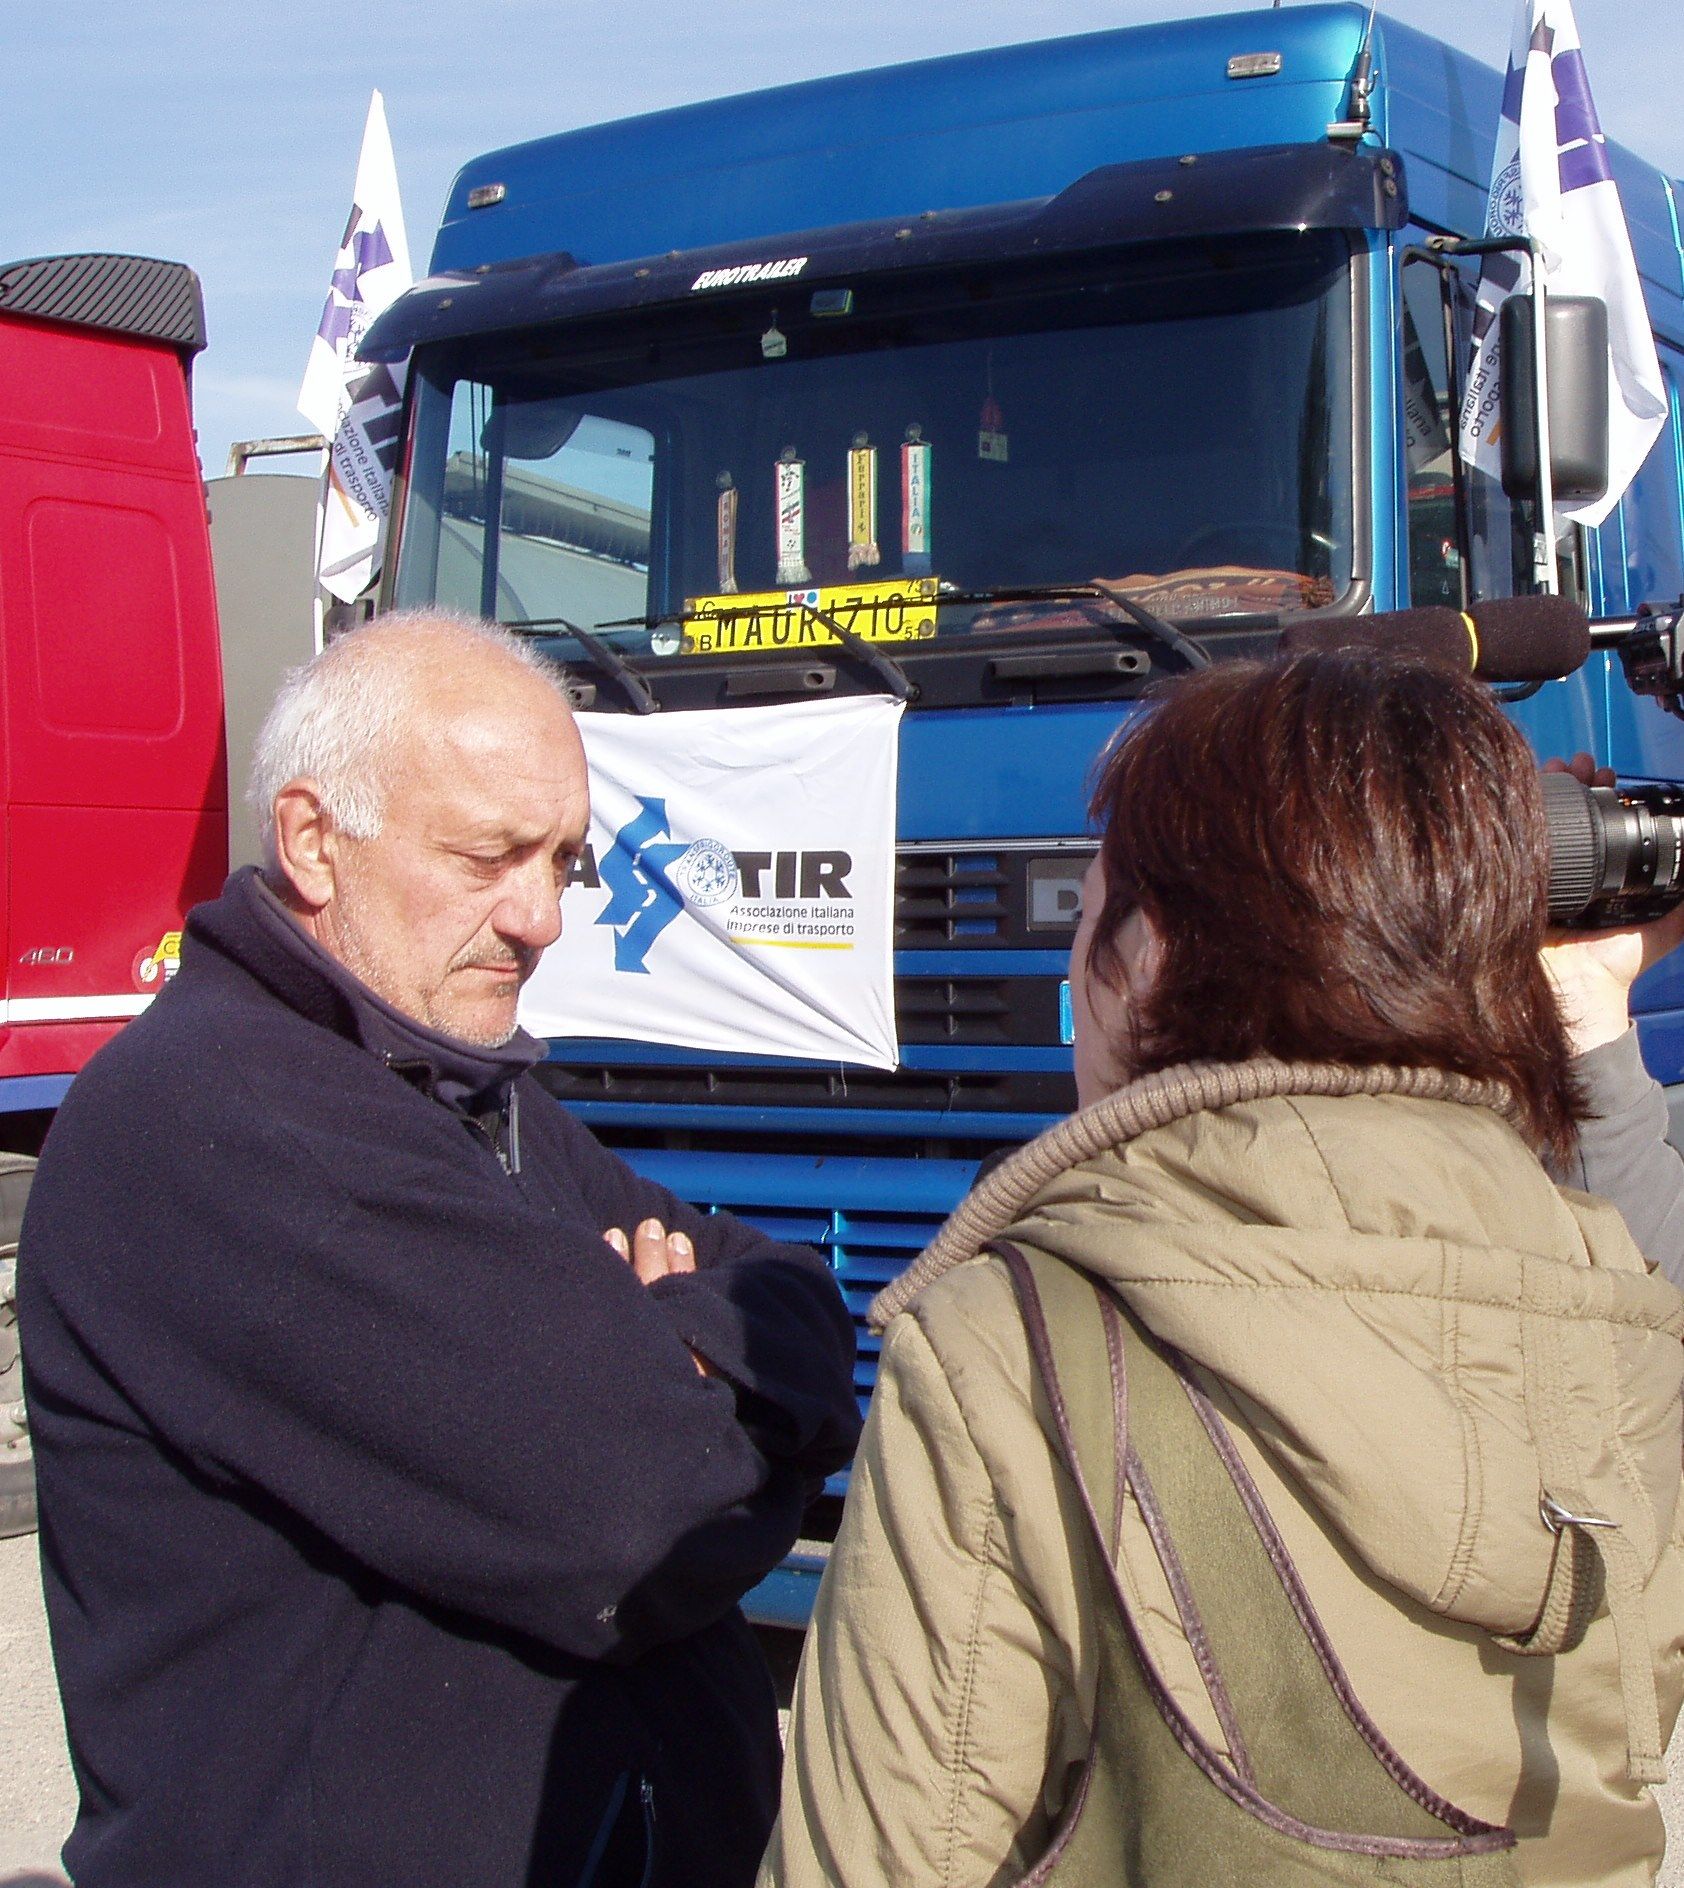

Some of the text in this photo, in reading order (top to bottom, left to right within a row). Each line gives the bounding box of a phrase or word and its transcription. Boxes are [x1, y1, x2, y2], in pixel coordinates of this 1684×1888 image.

[911, 454, 921, 517] ITALIA
[716, 593, 904, 647] MAURIZIO
[730, 905, 808, 918] Associazione
[783, 922, 794, 934] di
[797, 924, 854, 937] trasporto
